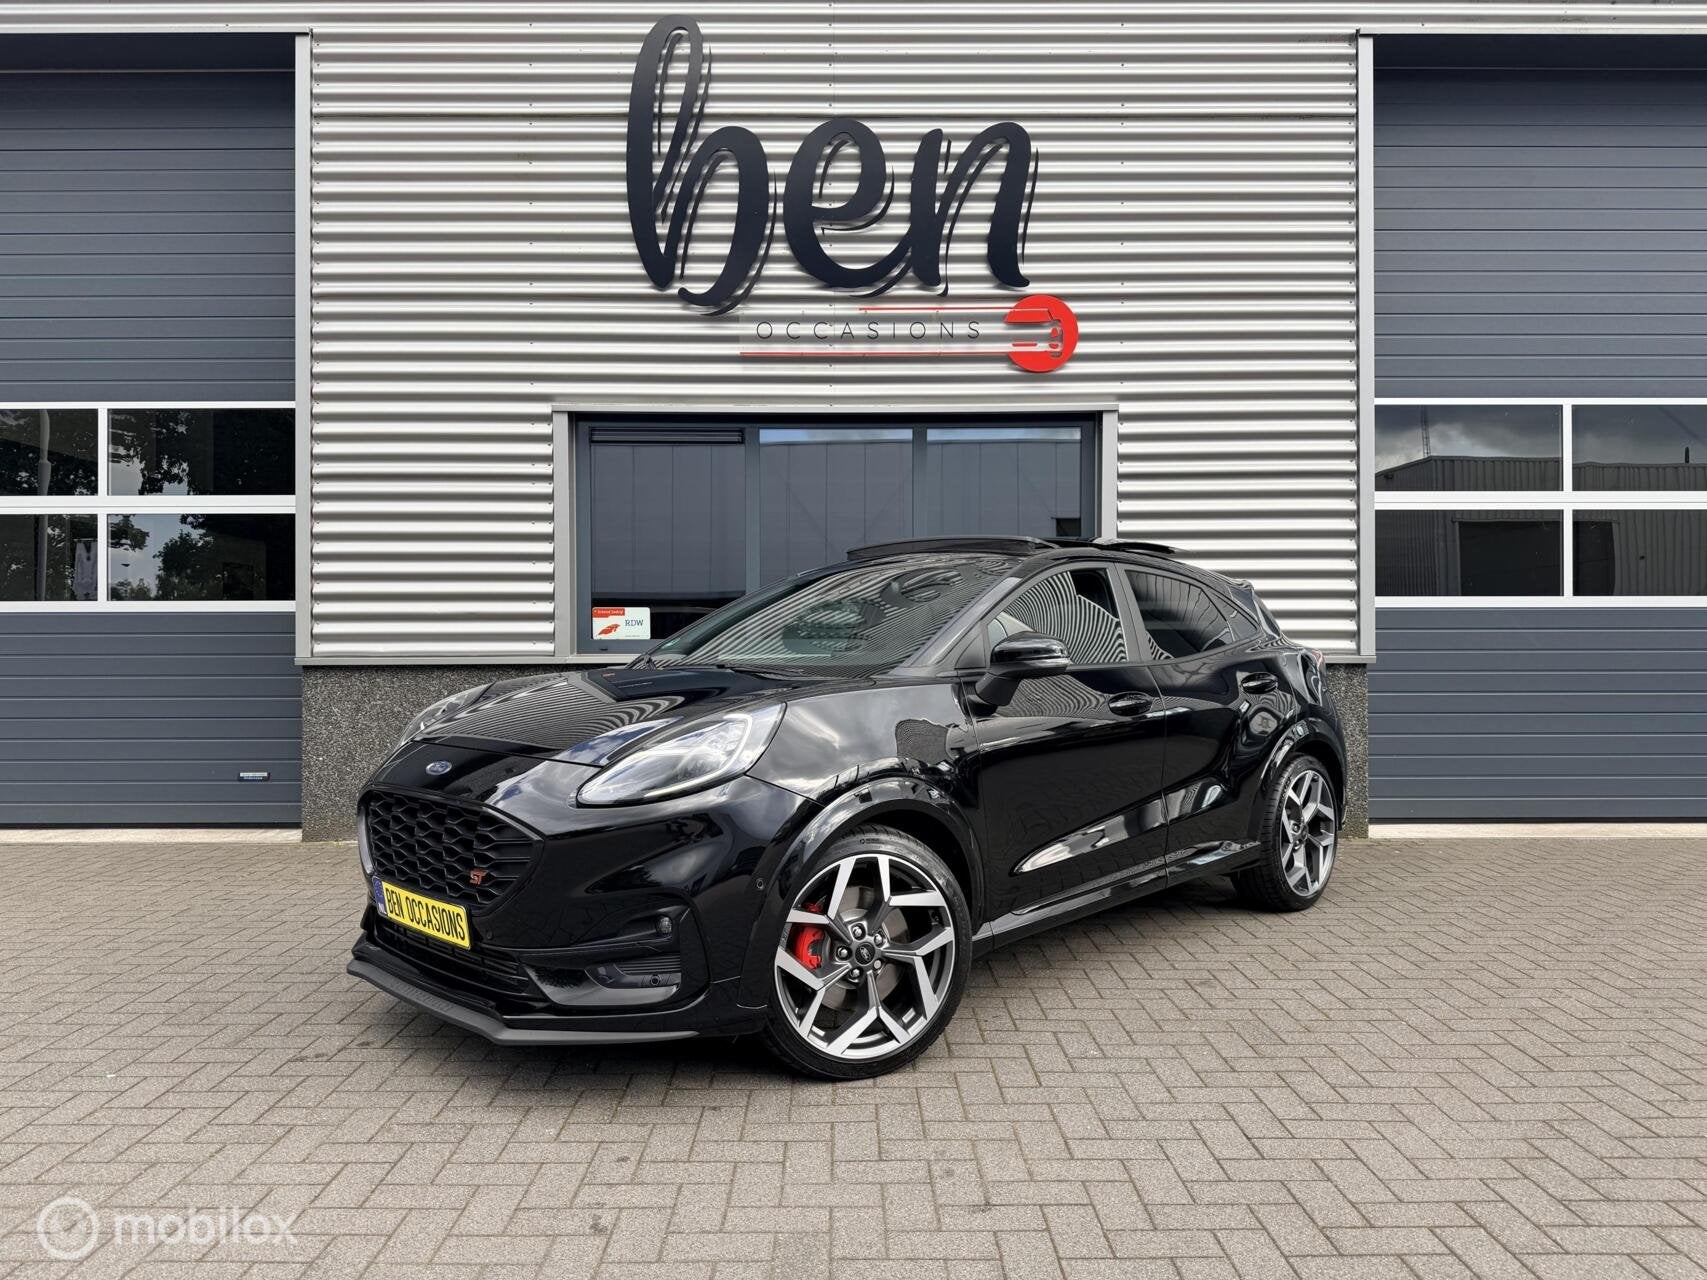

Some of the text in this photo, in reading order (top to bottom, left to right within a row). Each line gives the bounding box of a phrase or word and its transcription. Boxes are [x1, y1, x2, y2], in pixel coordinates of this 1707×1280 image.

[626, 14, 1039, 315] ben
[756, 321, 981, 340] OCCASIONS
[385, 888, 465, 941] BEN OCCASIONS
